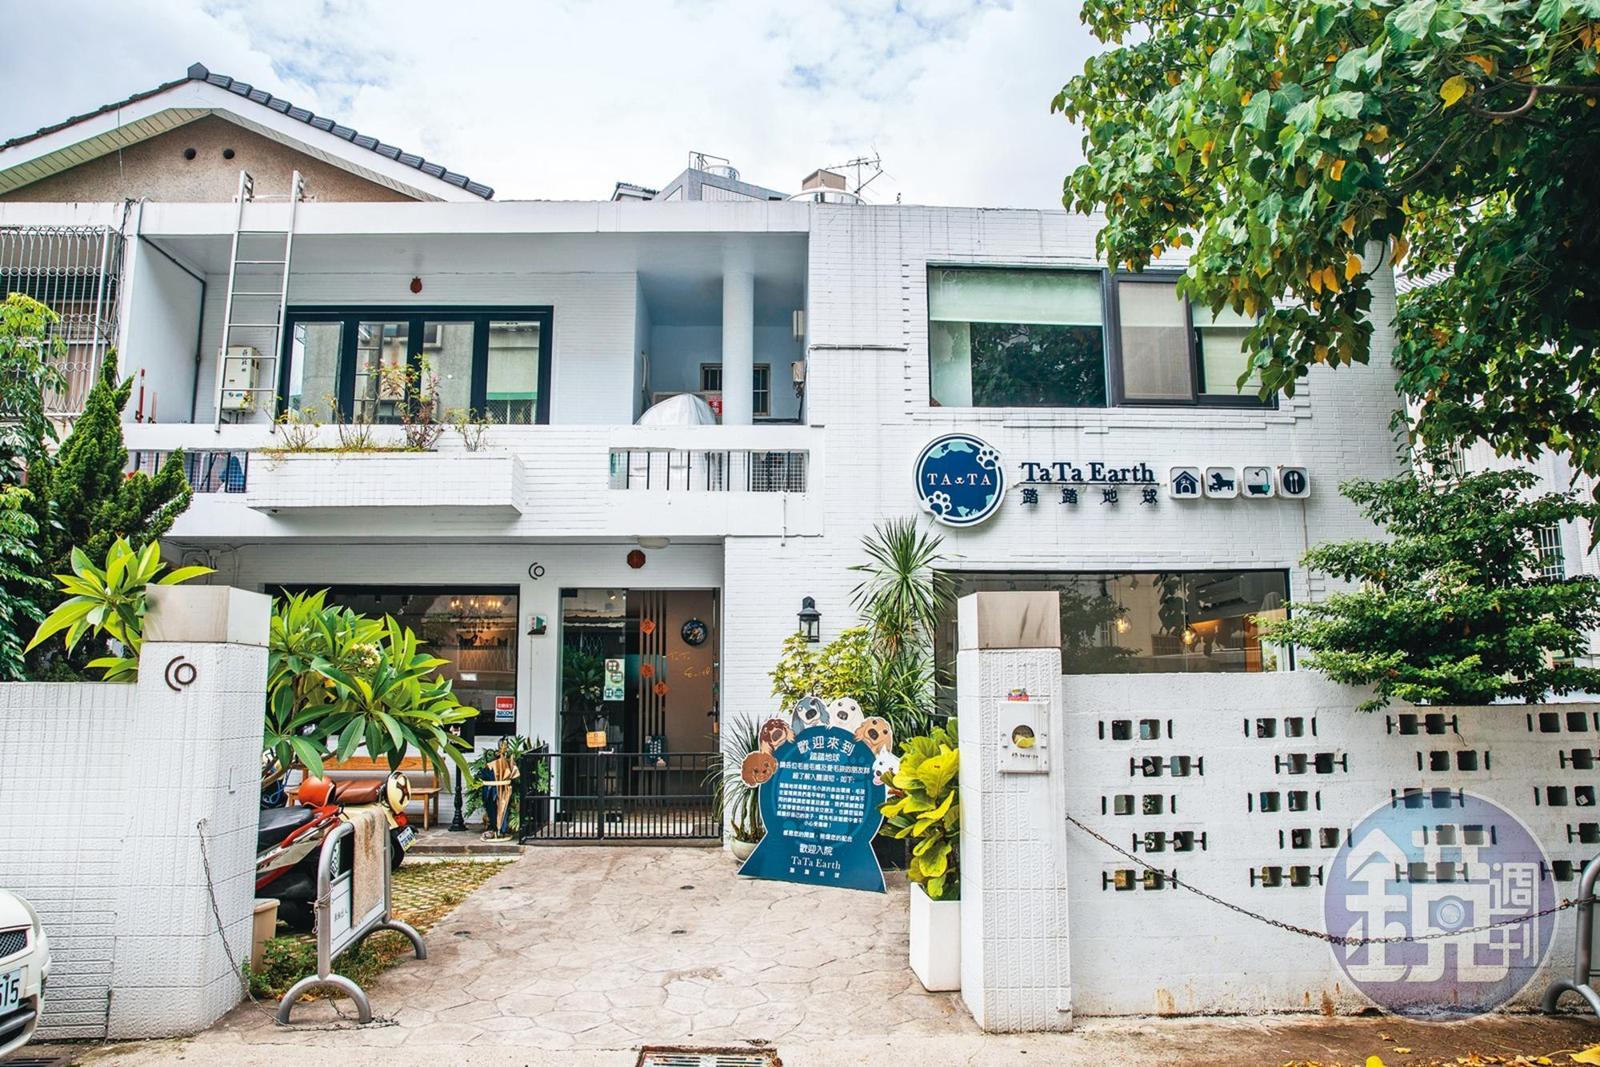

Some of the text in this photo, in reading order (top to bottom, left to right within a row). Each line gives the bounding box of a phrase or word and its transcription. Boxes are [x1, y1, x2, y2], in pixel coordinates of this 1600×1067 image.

[926, 473, 992, 486] TA TA
[1020, 461, 1154, 482] TaTa Earth
[1020, 487, 1159, 505] 踏踏地球
[796, 735, 856, 757] 歡迎來到
[791, 855, 841, 870] TaTa Earth
